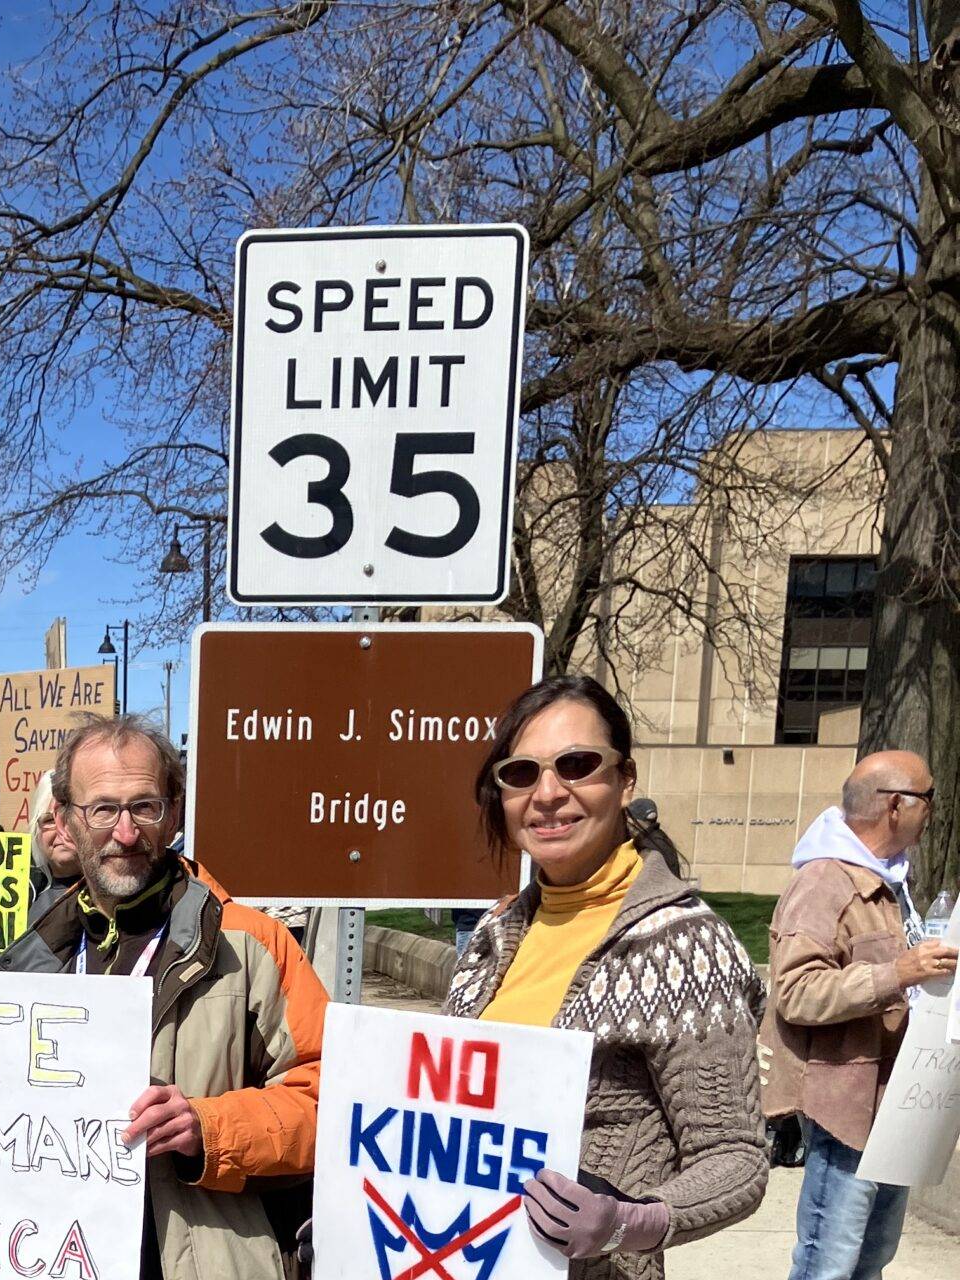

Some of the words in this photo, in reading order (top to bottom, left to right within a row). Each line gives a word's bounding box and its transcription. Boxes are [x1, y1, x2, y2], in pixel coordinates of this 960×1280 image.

[265, 276, 494, 333] SPEED
[286, 355, 465, 409] LIMIT
[260, 432, 480, 559] 35
[0, 677, 31, 712] ALL
[39, 673, 66, 708] WE
[70, 672, 104, 706] ARE
[14, 717, 73, 753] SAYIN
[226, 708, 312, 741] Edwin
[339, 709, 362, 741] J.
[389, 708, 498, 741] Simcox
[6, 757, 46, 792] GIV
[310, 792, 406, 831] Bridge
[749, 818, 796, 826] COUNTY
[406, 1031, 500, 1110] NO
[348, 1102, 549, 1196] KINGS
